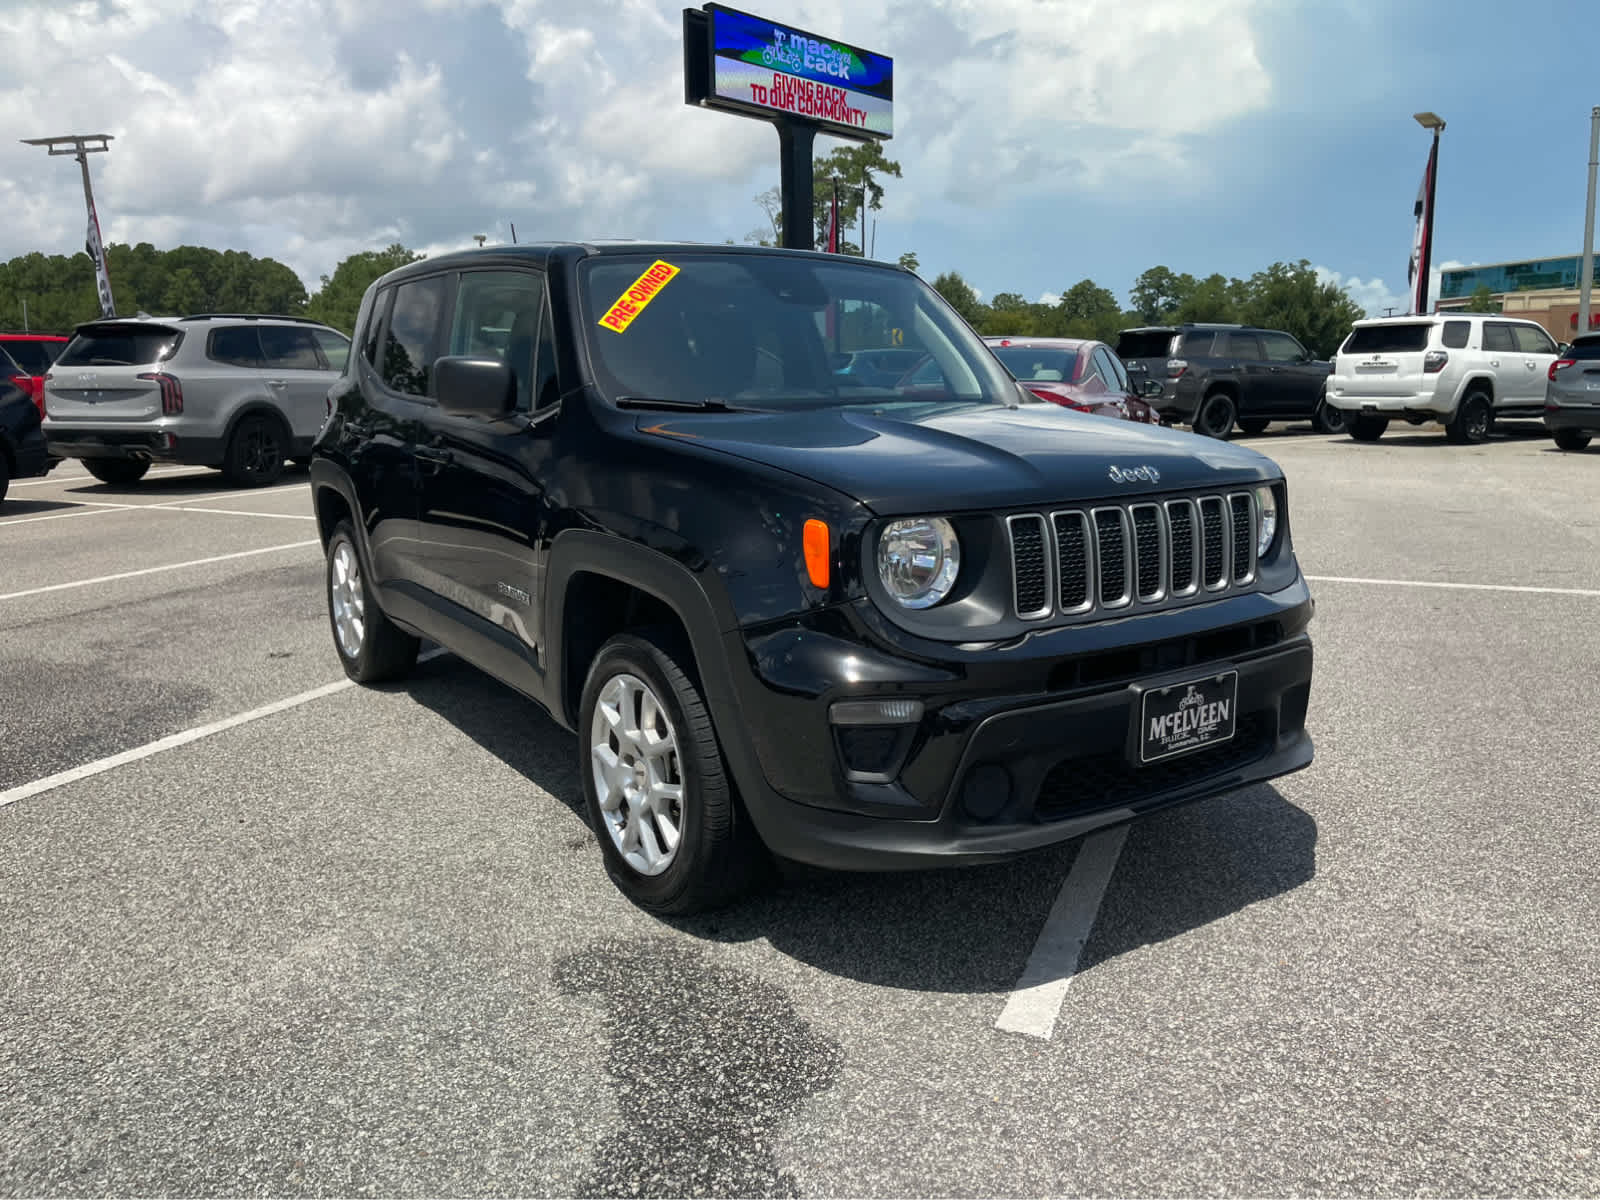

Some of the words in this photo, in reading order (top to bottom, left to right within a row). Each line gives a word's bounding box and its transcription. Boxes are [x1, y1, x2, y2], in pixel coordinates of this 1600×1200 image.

[790, 34, 832, 58] mac
[750, 84, 767, 103] TO
[770, 89, 795, 112] OUR
[798, 95, 867, 126] COMMUNITY
[774, 73, 813, 100] GIVING
[816, 84, 847, 105] BACK
[604, 264, 672, 329] PRE-OWNED
